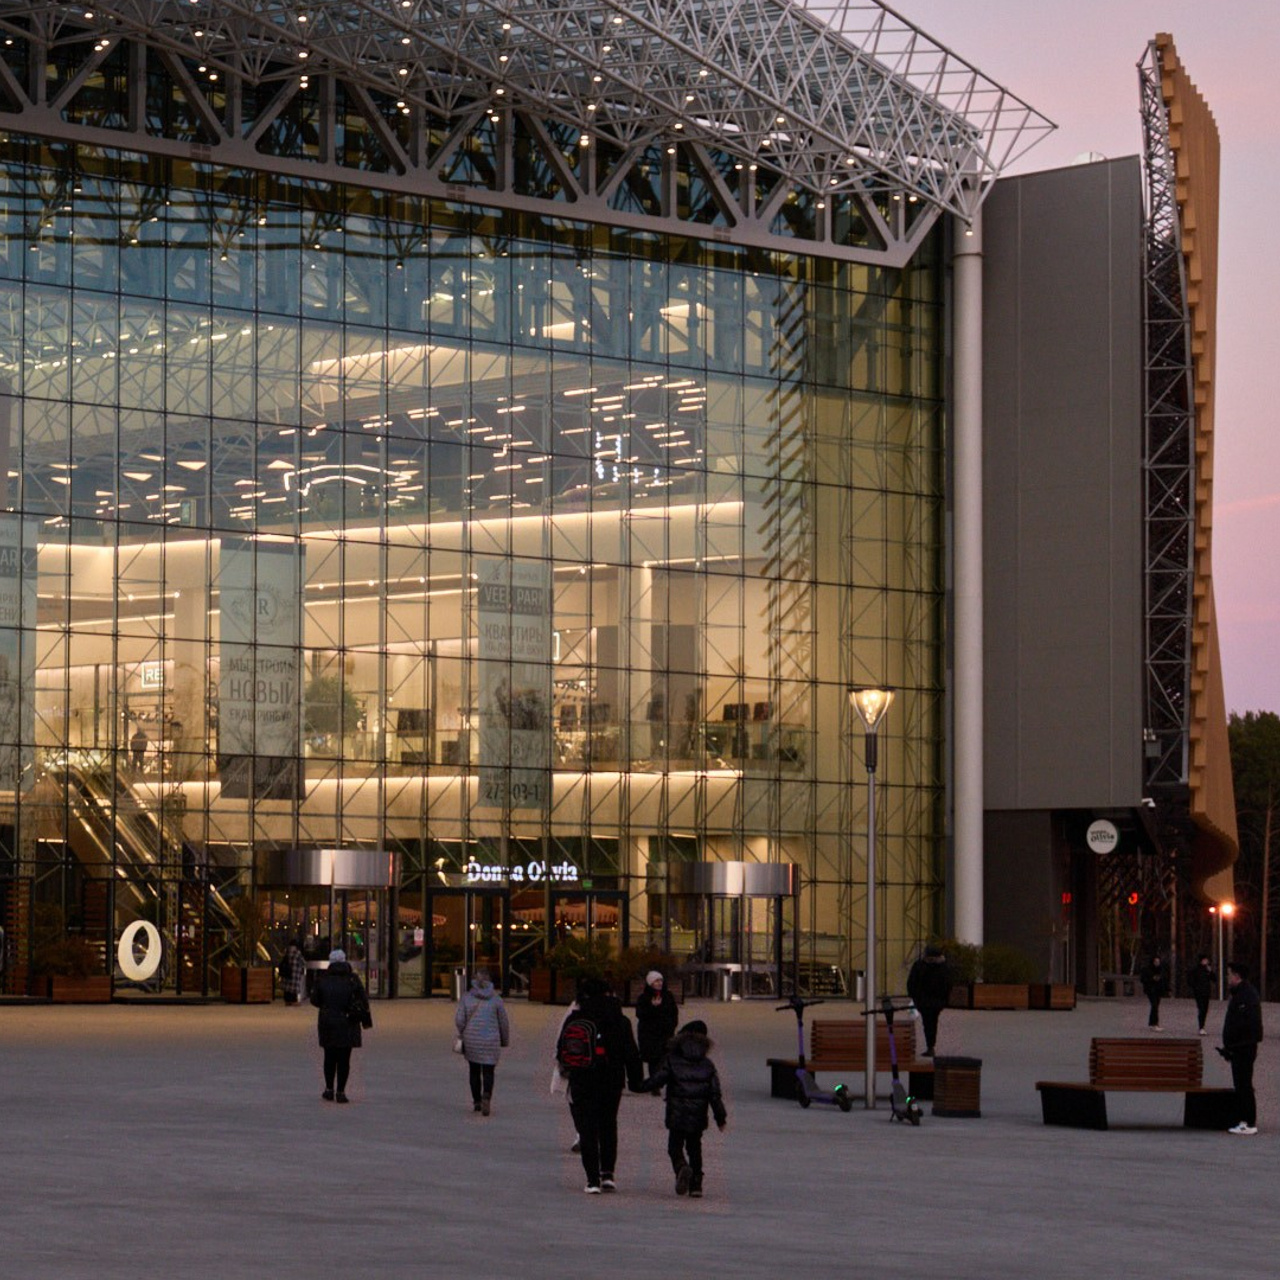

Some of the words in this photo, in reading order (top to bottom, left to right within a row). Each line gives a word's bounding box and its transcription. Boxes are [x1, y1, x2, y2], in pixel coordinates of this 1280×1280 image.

[484, 586, 510, 603] VEE
[468, 862, 524, 881] Dona
[528, 861, 578, 881] Olvia
